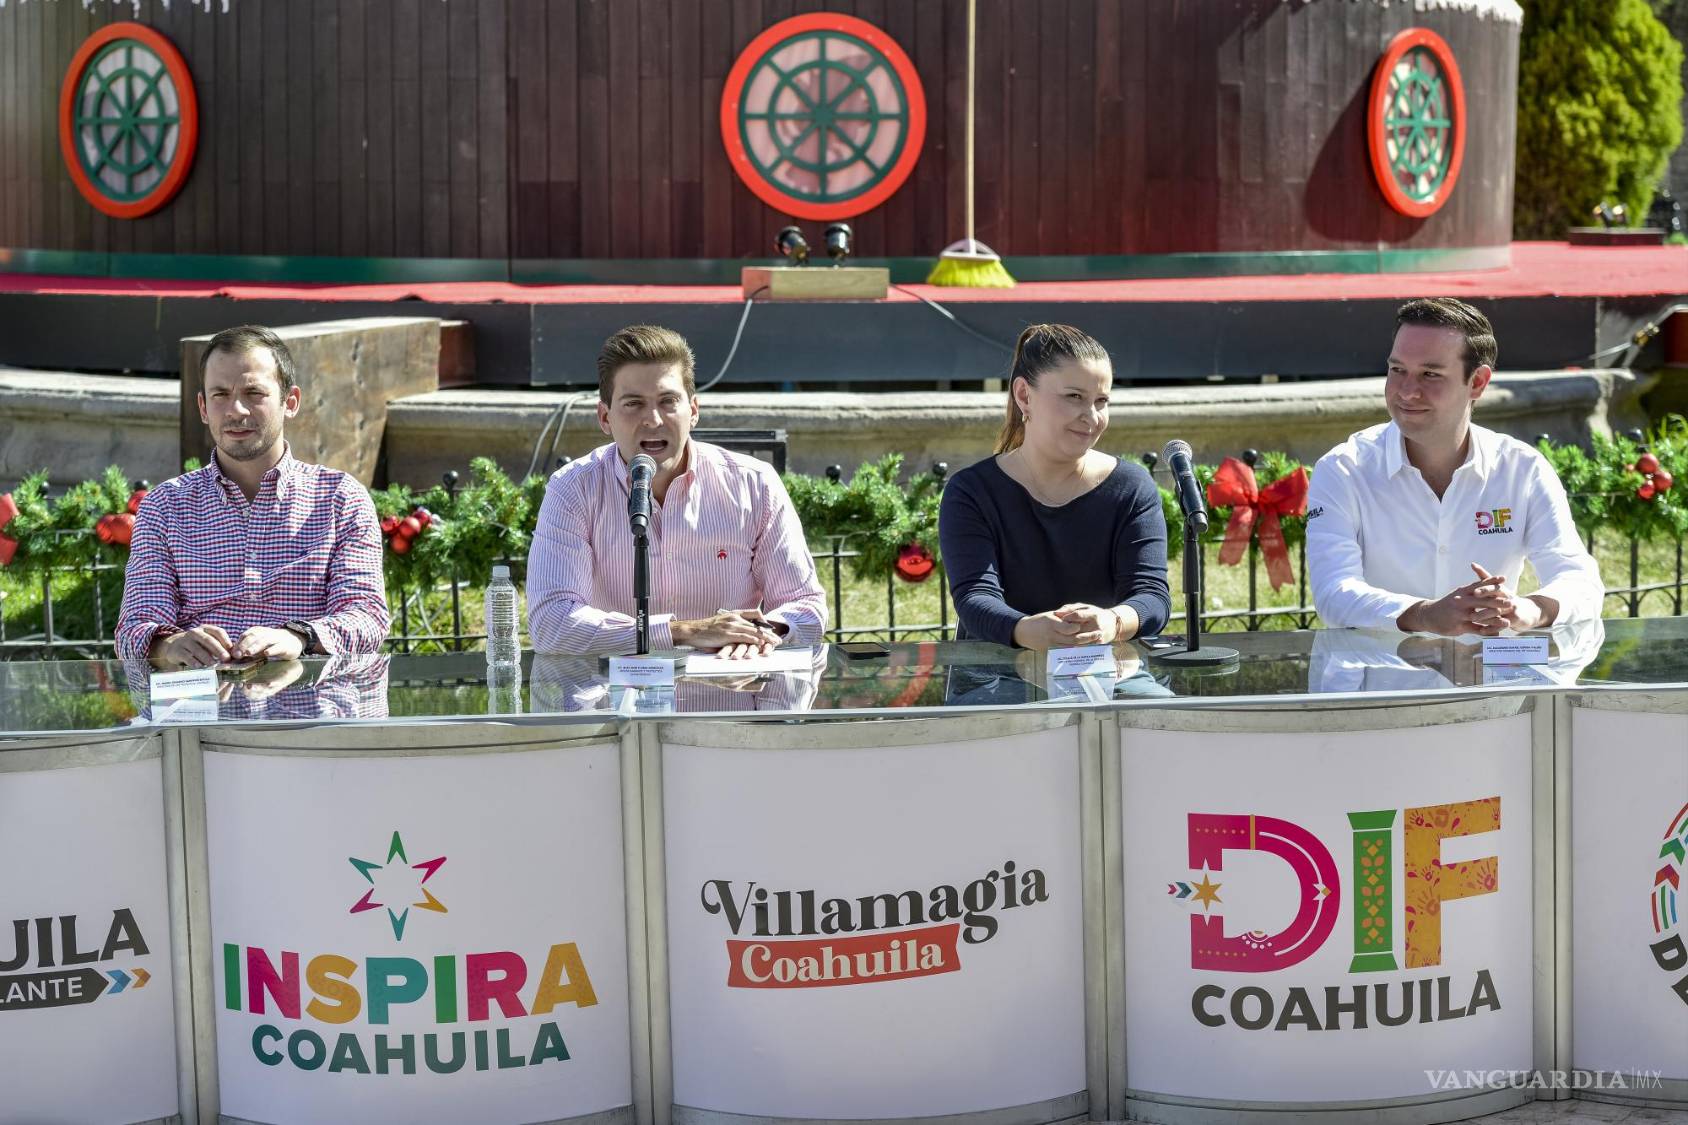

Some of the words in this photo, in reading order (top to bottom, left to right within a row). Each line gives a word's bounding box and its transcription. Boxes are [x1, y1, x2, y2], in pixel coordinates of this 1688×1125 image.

[1476, 508, 1511, 528] DIF
[1478, 527, 1513, 535] COAHUILA
[701, 861, 1049, 945] Villamagia
[1188, 796, 1500, 973] DIF
[224, 942, 597, 1023] INSPIRA
[741, 940, 945, 984] Coahuila
[0, 977, 83, 1005] ANTE
[1191, 969, 1501, 1031] COAHUILA
[252, 1022, 571, 1075] COAHUILA
